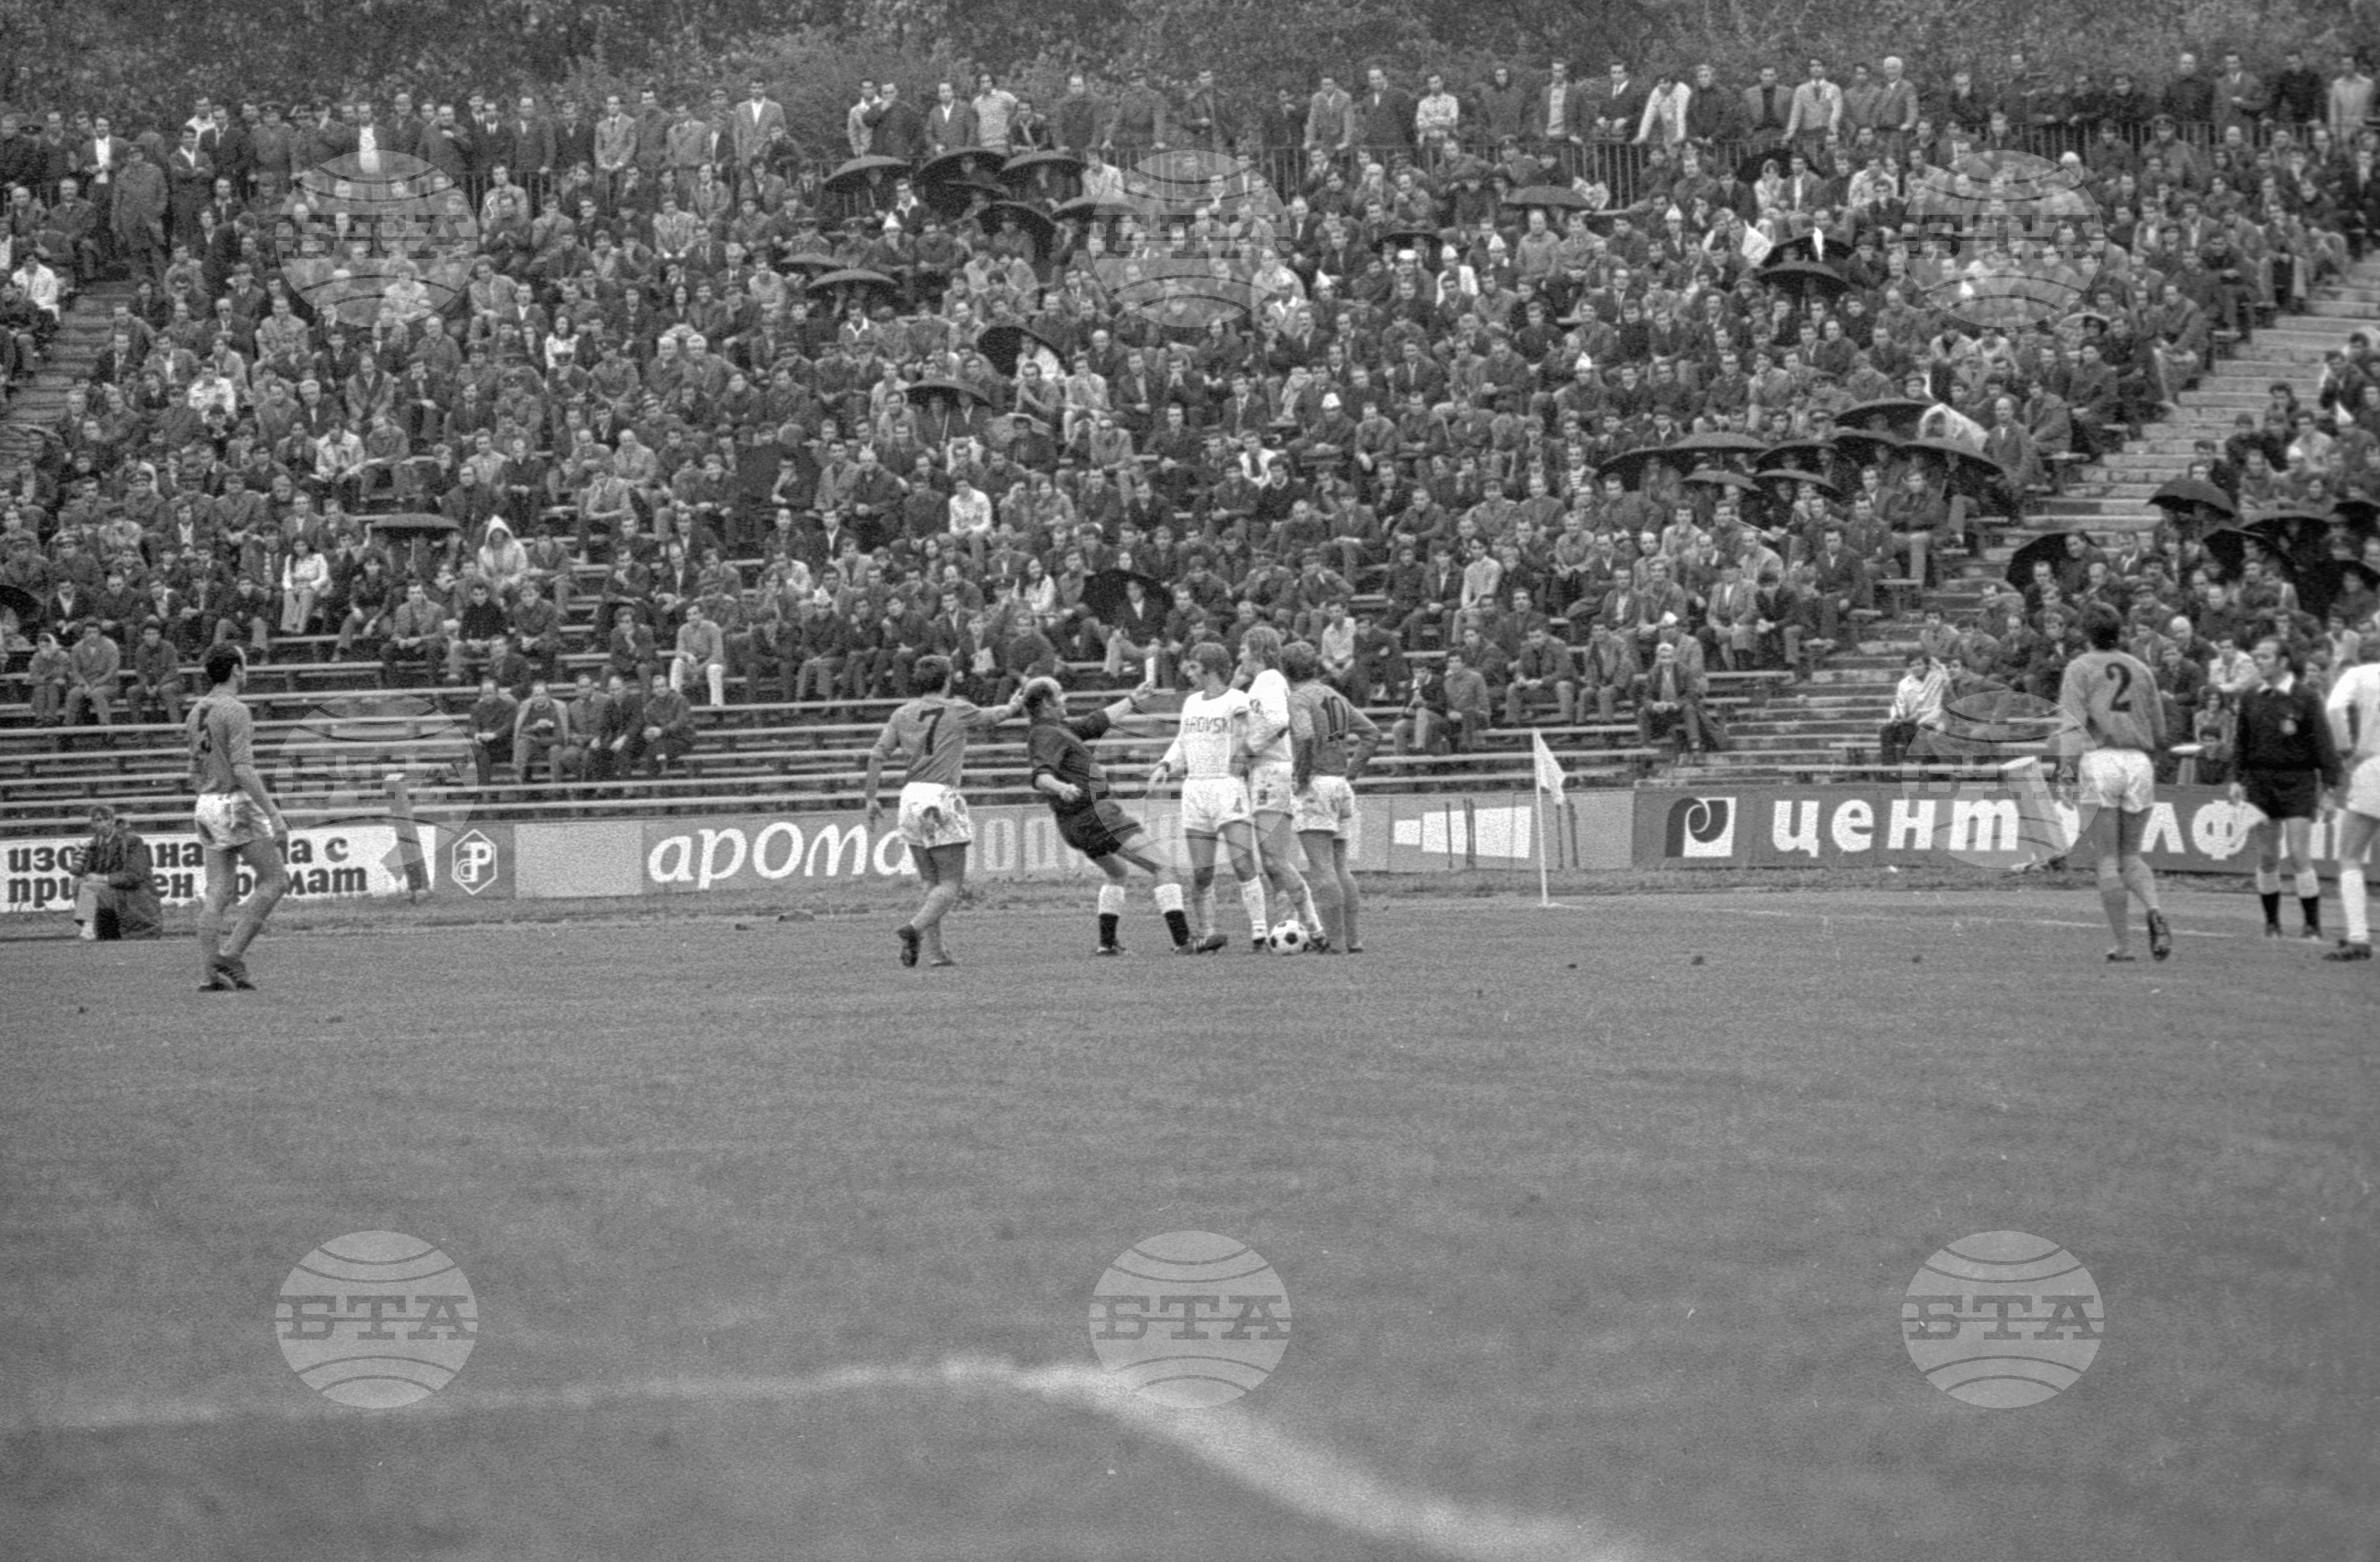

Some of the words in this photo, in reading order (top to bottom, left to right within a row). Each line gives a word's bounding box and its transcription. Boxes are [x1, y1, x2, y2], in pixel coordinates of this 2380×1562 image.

[2105, 662, 2131, 712] 2
[918, 707, 945, 755] 7
[1320, 696, 1346, 742] 10
[325, 837, 349, 863] с
